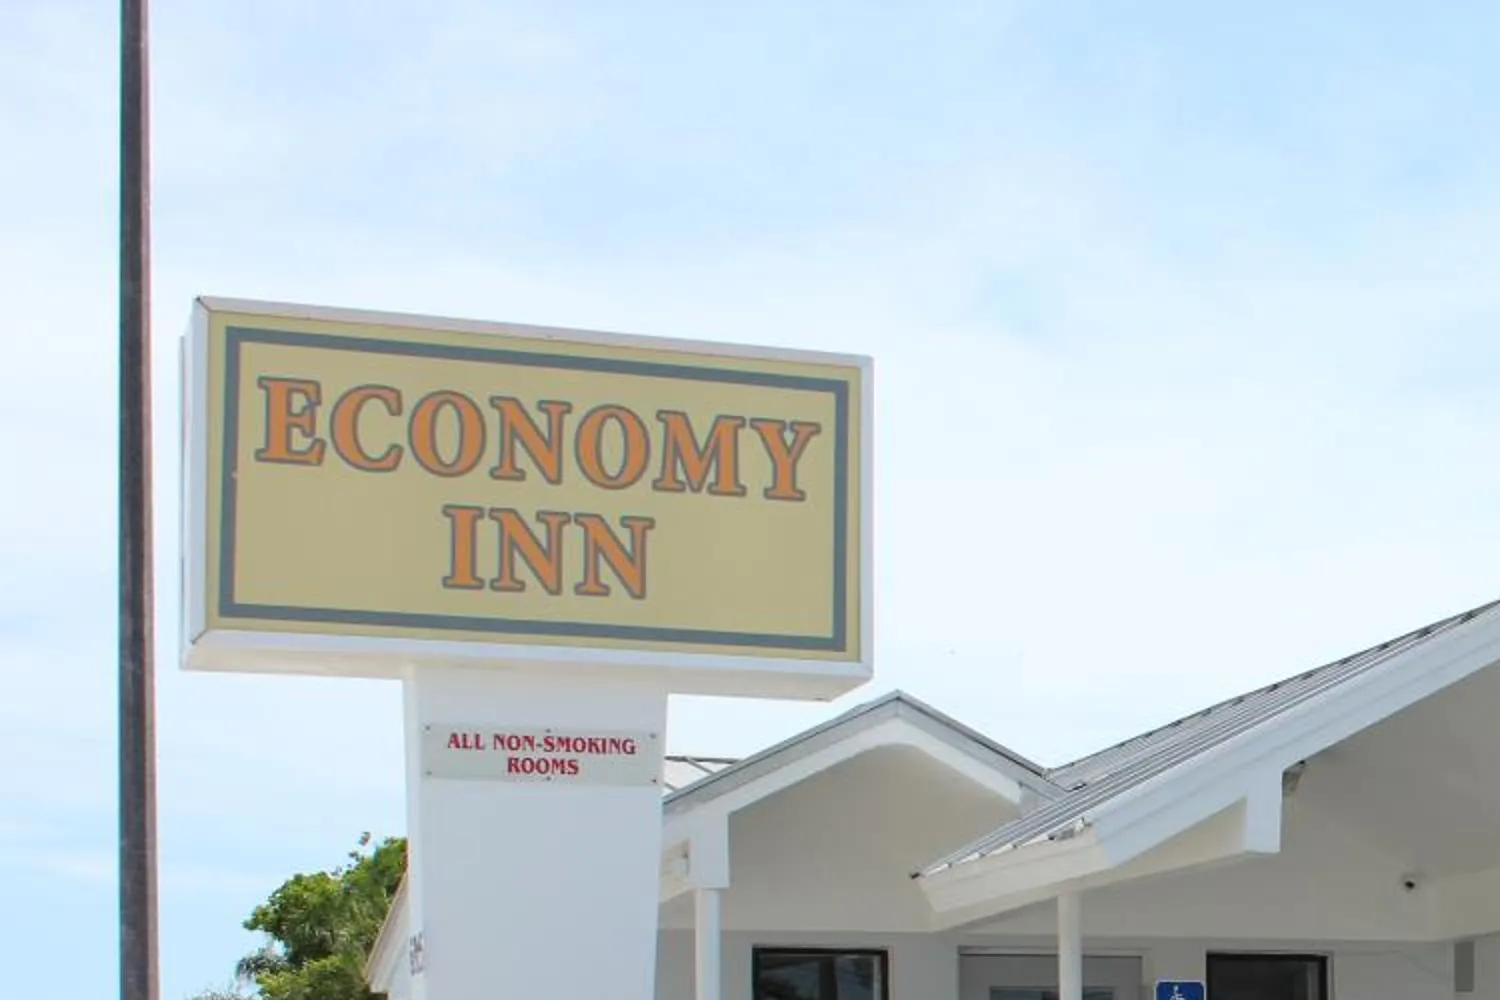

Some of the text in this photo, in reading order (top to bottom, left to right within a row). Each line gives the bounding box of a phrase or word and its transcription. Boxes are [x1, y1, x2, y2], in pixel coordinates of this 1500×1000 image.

[254, 375, 822, 502] ECONOMY
[441, 504, 656, 600] INN
[447, 732, 636, 755] ALL NON-SMOKING
[507, 756, 579, 776] ROOMS
